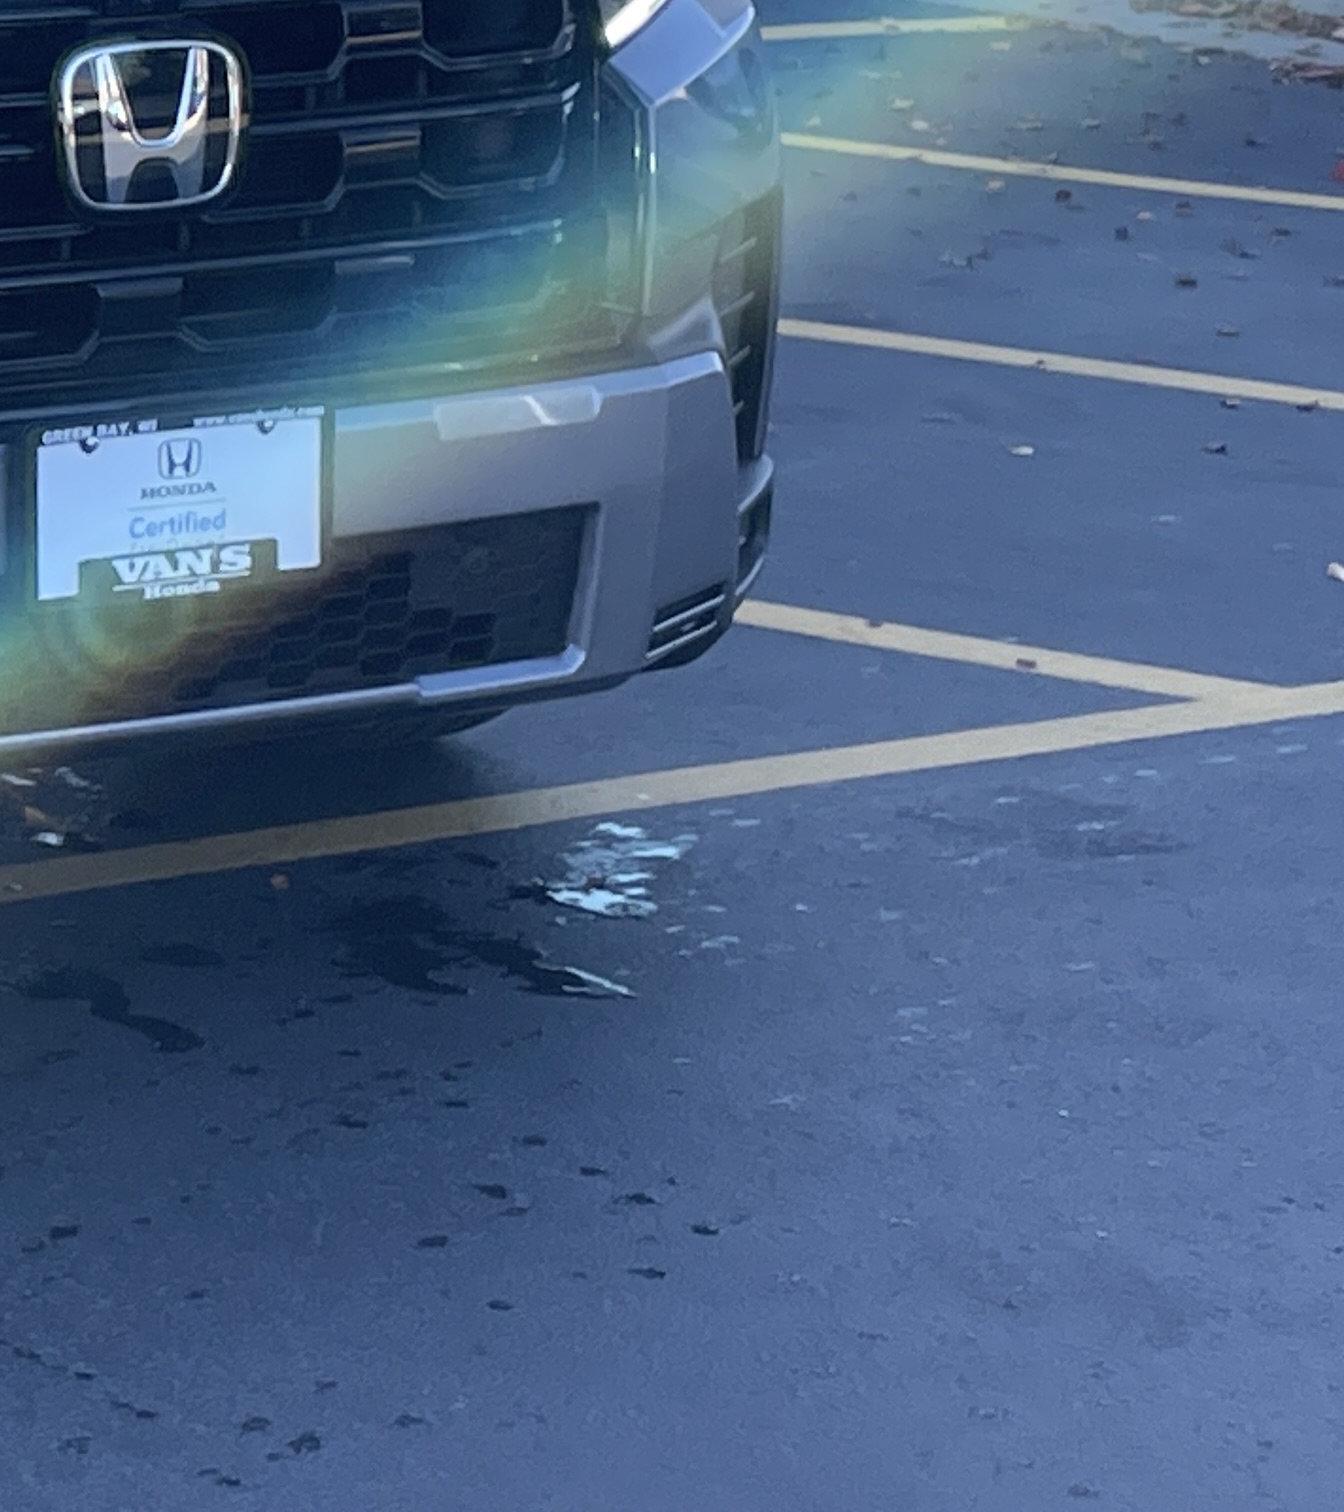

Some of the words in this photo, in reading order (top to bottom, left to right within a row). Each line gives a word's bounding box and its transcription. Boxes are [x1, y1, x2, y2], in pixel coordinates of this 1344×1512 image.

[139, 481, 217, 500] HONDA
[129, 507, 226, 539] Certified
[143, 578, 221, 600] Honda
